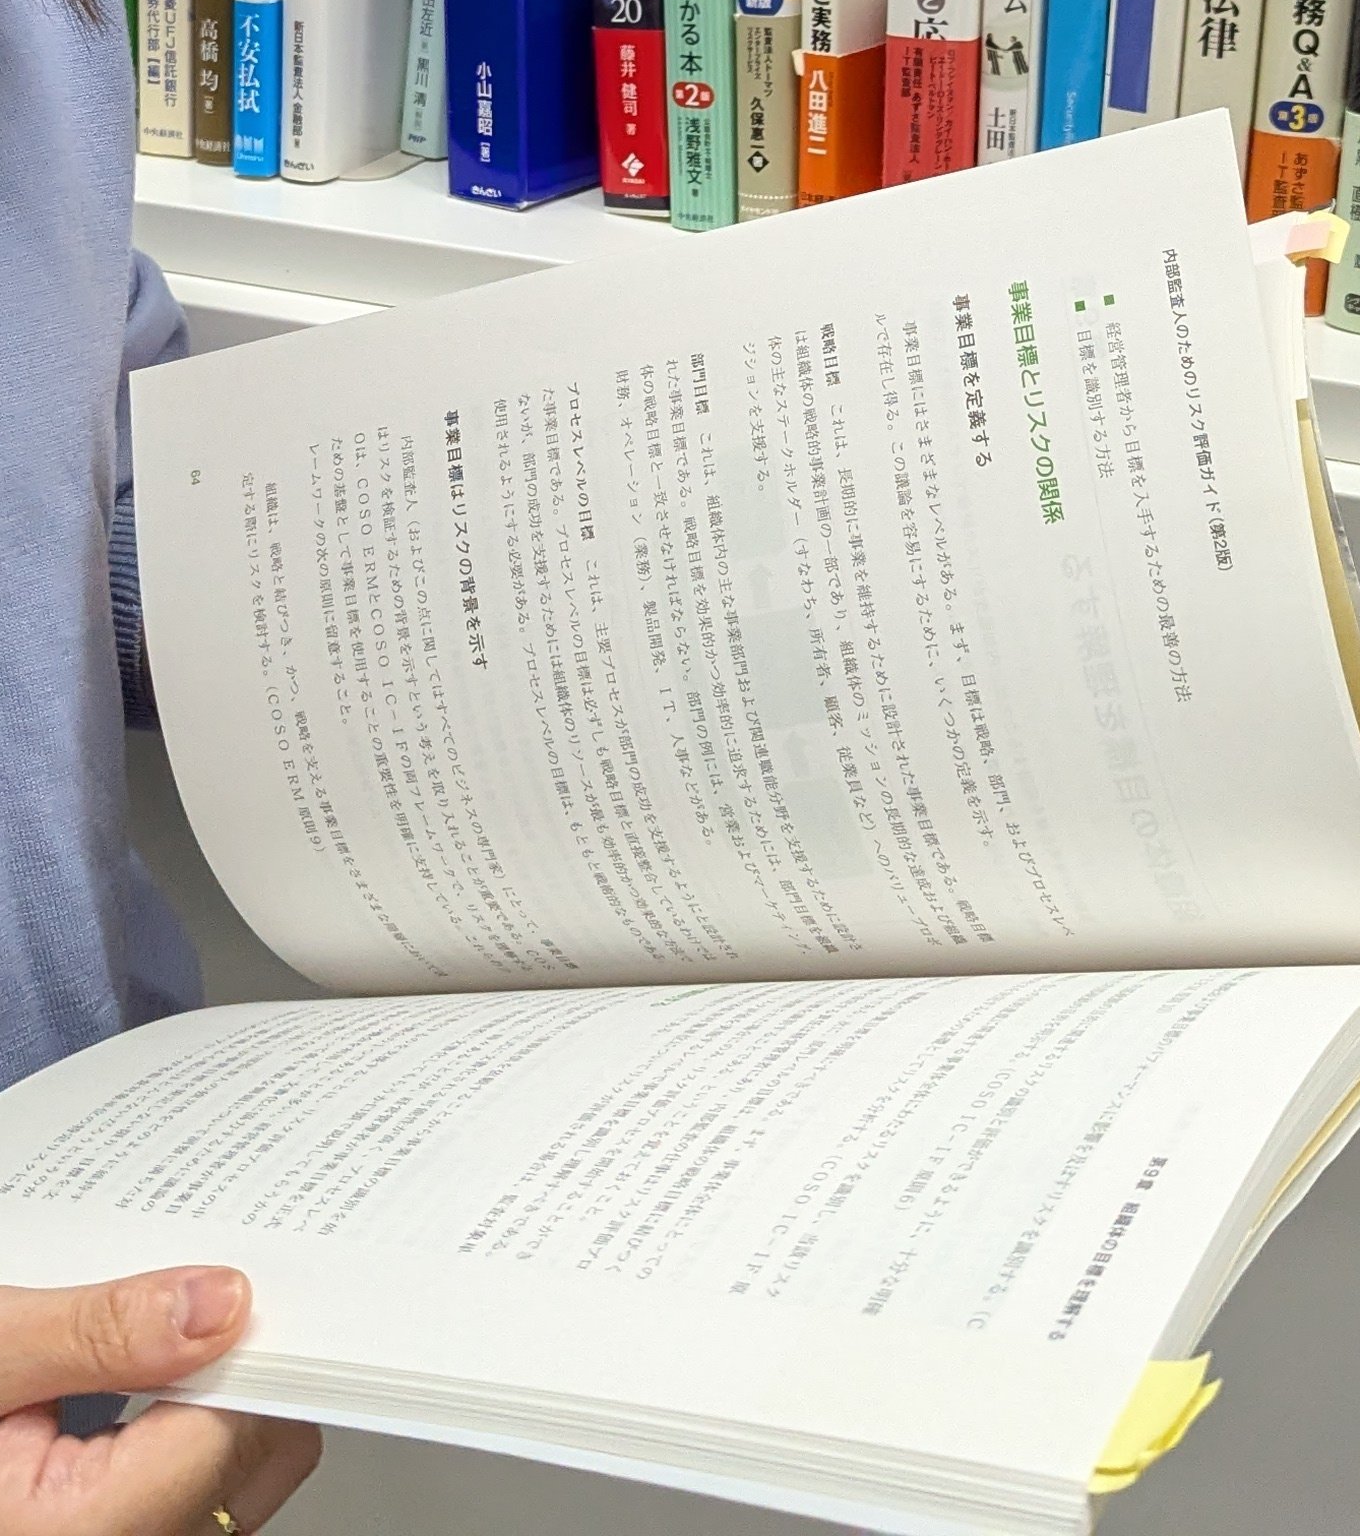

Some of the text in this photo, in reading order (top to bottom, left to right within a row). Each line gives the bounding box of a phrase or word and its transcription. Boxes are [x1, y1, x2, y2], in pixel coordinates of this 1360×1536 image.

[238, 14, 260, 113] 不安払拭
[476, 62, 495, 138] 小山嘉昭
[619, 44, 639, 117] 藤井 健司
[807, 69, 829, 156] 八田進二
[690, 353, 712, 415] 部門目標
[741, 341, 772, 493] ジションを支援する。
[819, 323, 843, 387] 戦略目標
[950, 294, 993, 468] 事業目標を定義する
[1008, 280, 1066, 525] 事業目標とリスクの関係
[1076, 329, 1115, 479] 目標を識別する方法
[189, 470, 202, 486] 64
[564, 382, 597, 541] プロセスレベルの目標
[1105, 322, 1193, 704] 経営管理者から目標を入手するための最善の方法
[442, 410, 489, 671] 事業目標はリスクの背景を示す
